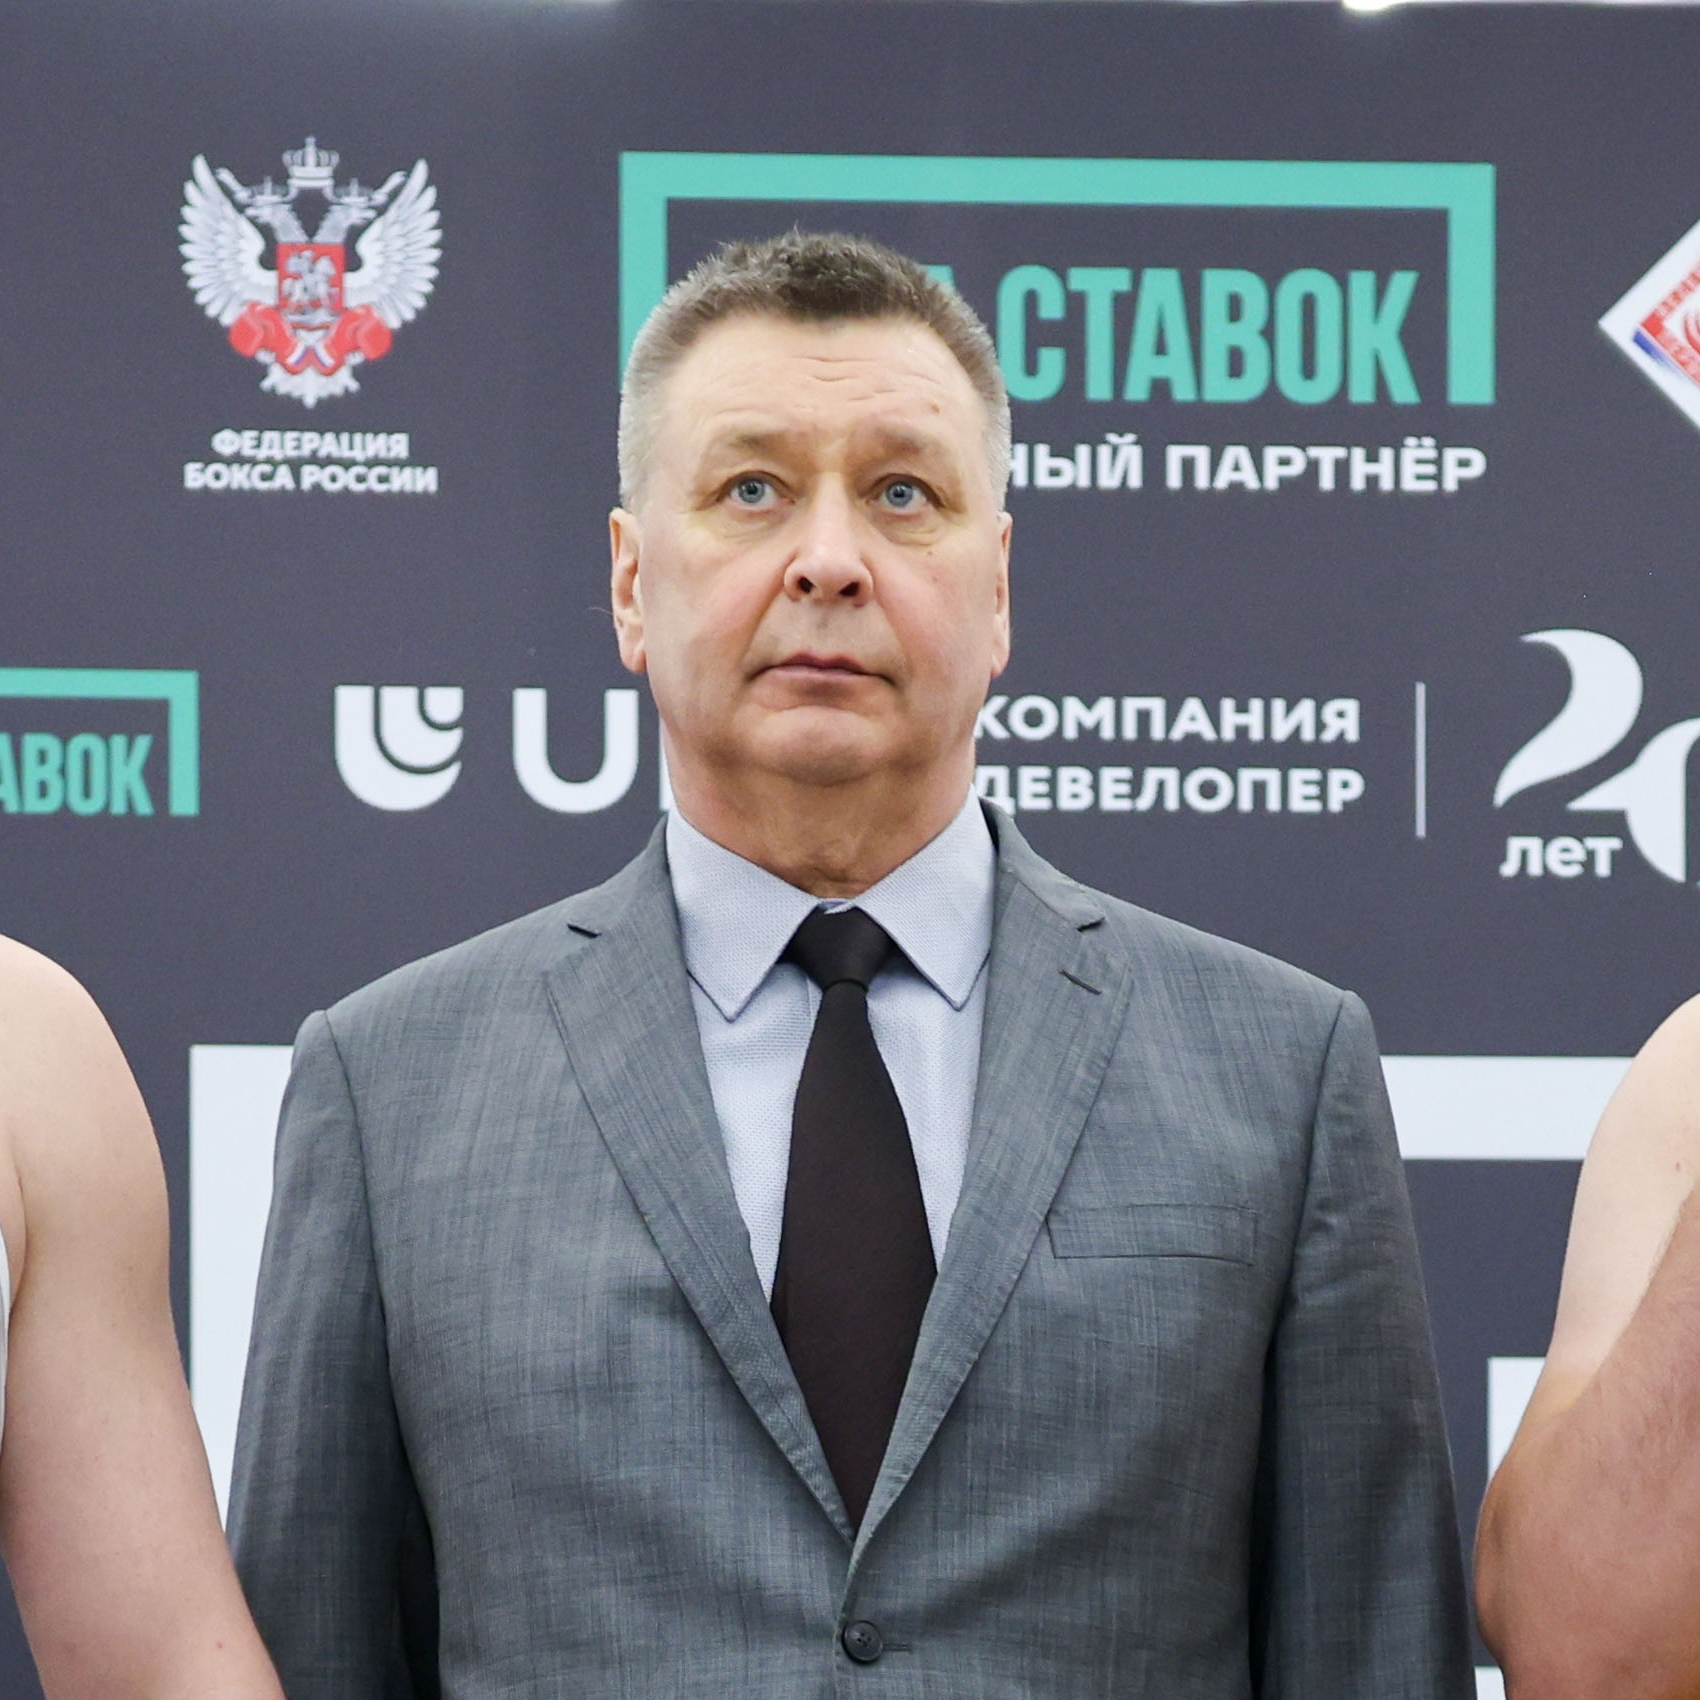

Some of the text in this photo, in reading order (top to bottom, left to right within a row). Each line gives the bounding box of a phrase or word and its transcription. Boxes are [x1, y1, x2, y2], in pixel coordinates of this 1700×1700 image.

[996, 264, 1420, 404] СТАВОК
[211, 429, 409, 460] ФЕДЕРАЦИЯ
[1165, 437, 1488, 492] ПАРТНЁР
[184, 463, 438, 493] БОКСА РОССИИ
[974, 695, 1361, 743] КОМПАНИЯ
[975, 765, 1366, 816] ДЕВЕЛОПЕР
[1500, 834, 1623, 878] лет
